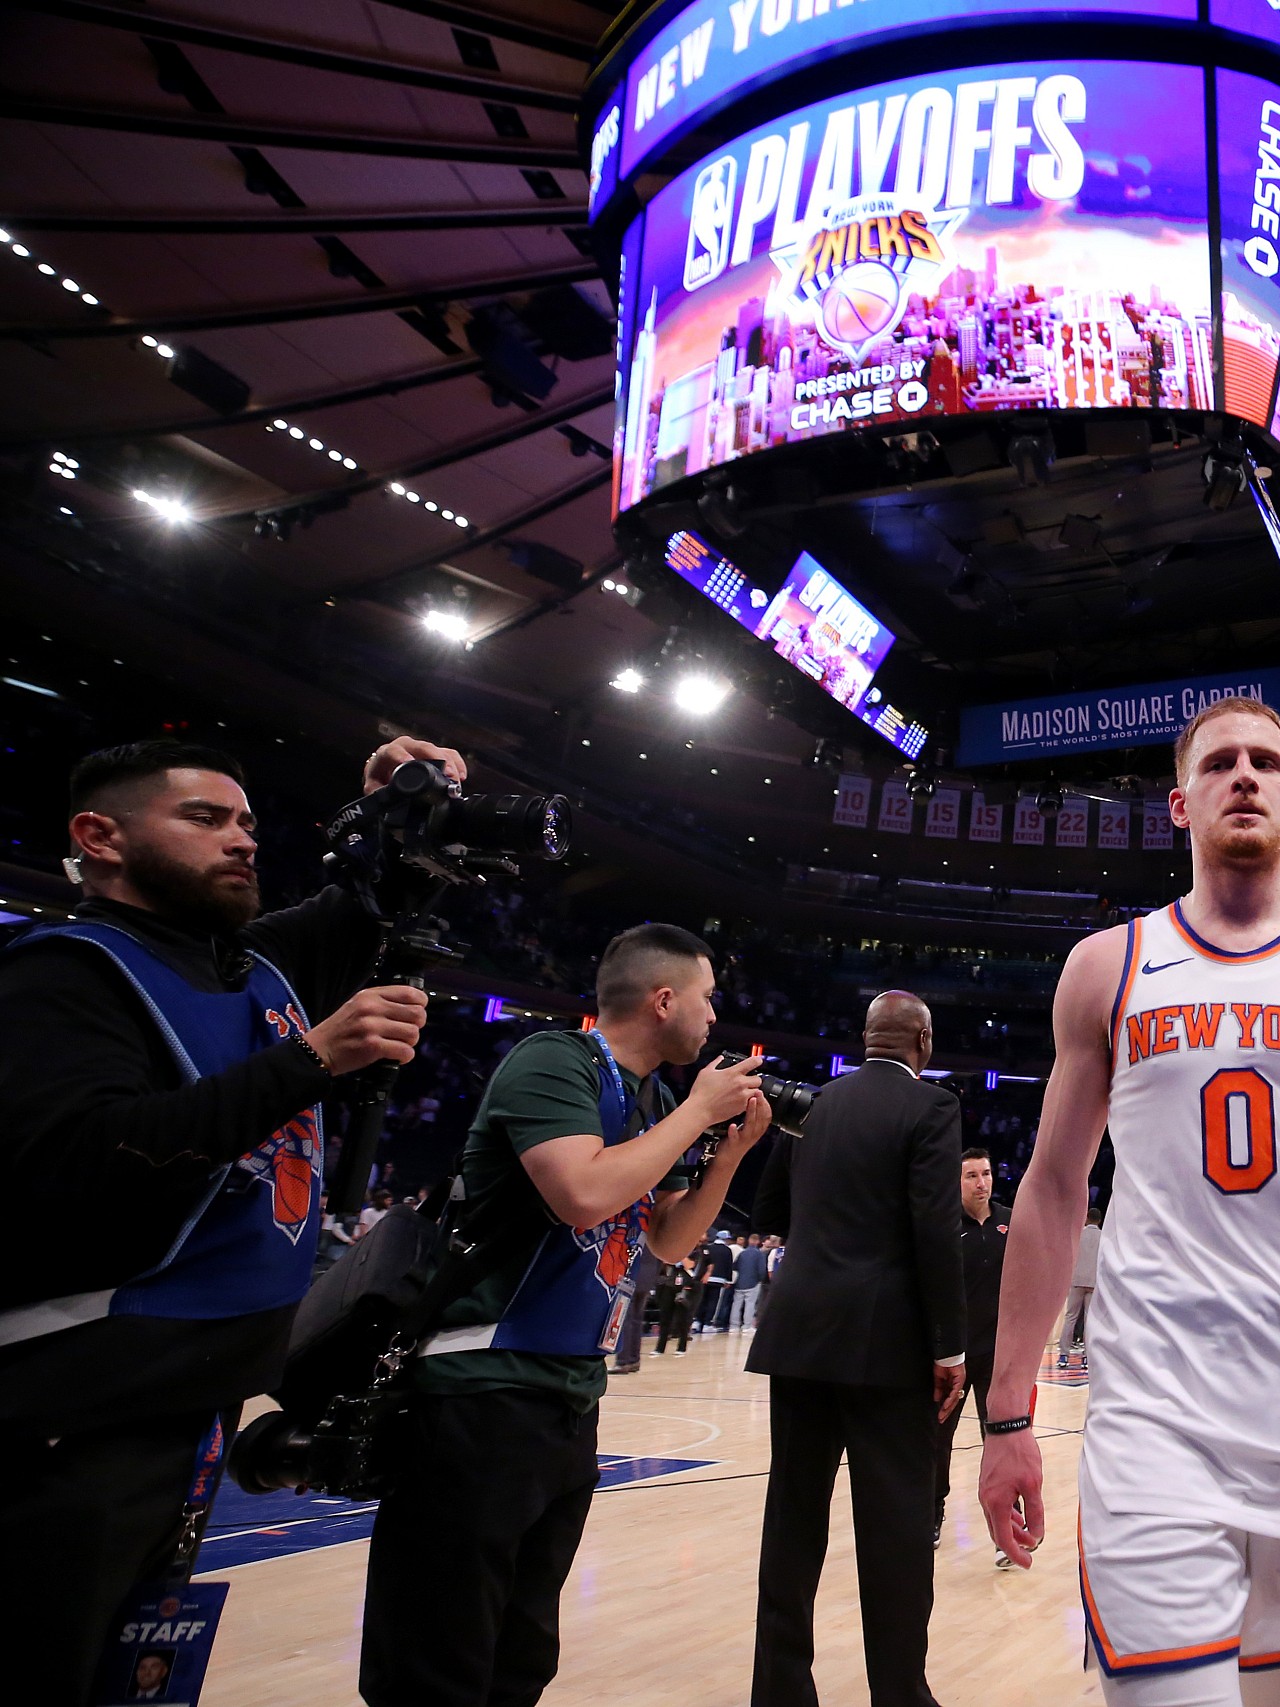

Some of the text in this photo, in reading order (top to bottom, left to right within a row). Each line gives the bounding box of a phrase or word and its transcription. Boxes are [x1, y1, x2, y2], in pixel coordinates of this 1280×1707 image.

[634, 0, 856, 132] NEW YO
[732, 74, 1087, 267] PLAYOFFS
[862, 200, 895, 217] YORK
[799, 209, 946, 285] KNICKS
[795, 359, 926, 400] PRESENTED BY
[790, 388, 894, 430] CHASE
[1002, 704, 1090, 742] MADISON
[1097, 694, 1175, 731] SQUARE
[1040, 724, 1185, 748] THE WORLD'S MOST FAMOUS
[841, 789, 864, 811] 10
[885, 797, 908, 817] 12
[326, 804, 364, 841] RONIN
[932, 803, 954, 822] 15
[976, 806, 997, 826] 15
[1019, 811, 1040, 829] 19
[1059, 813, 1085, 832] 22
[927, 825, 956, 836] KNICKS
[1102, 815, 1127, 834] 24
[1146, 816, 1171, 834] 33
[1126, 1002, 1226, 1067] NEW
[1200, 1067, 1278, 1196] 0
[120, 1621, 207, 1644] STAFF
